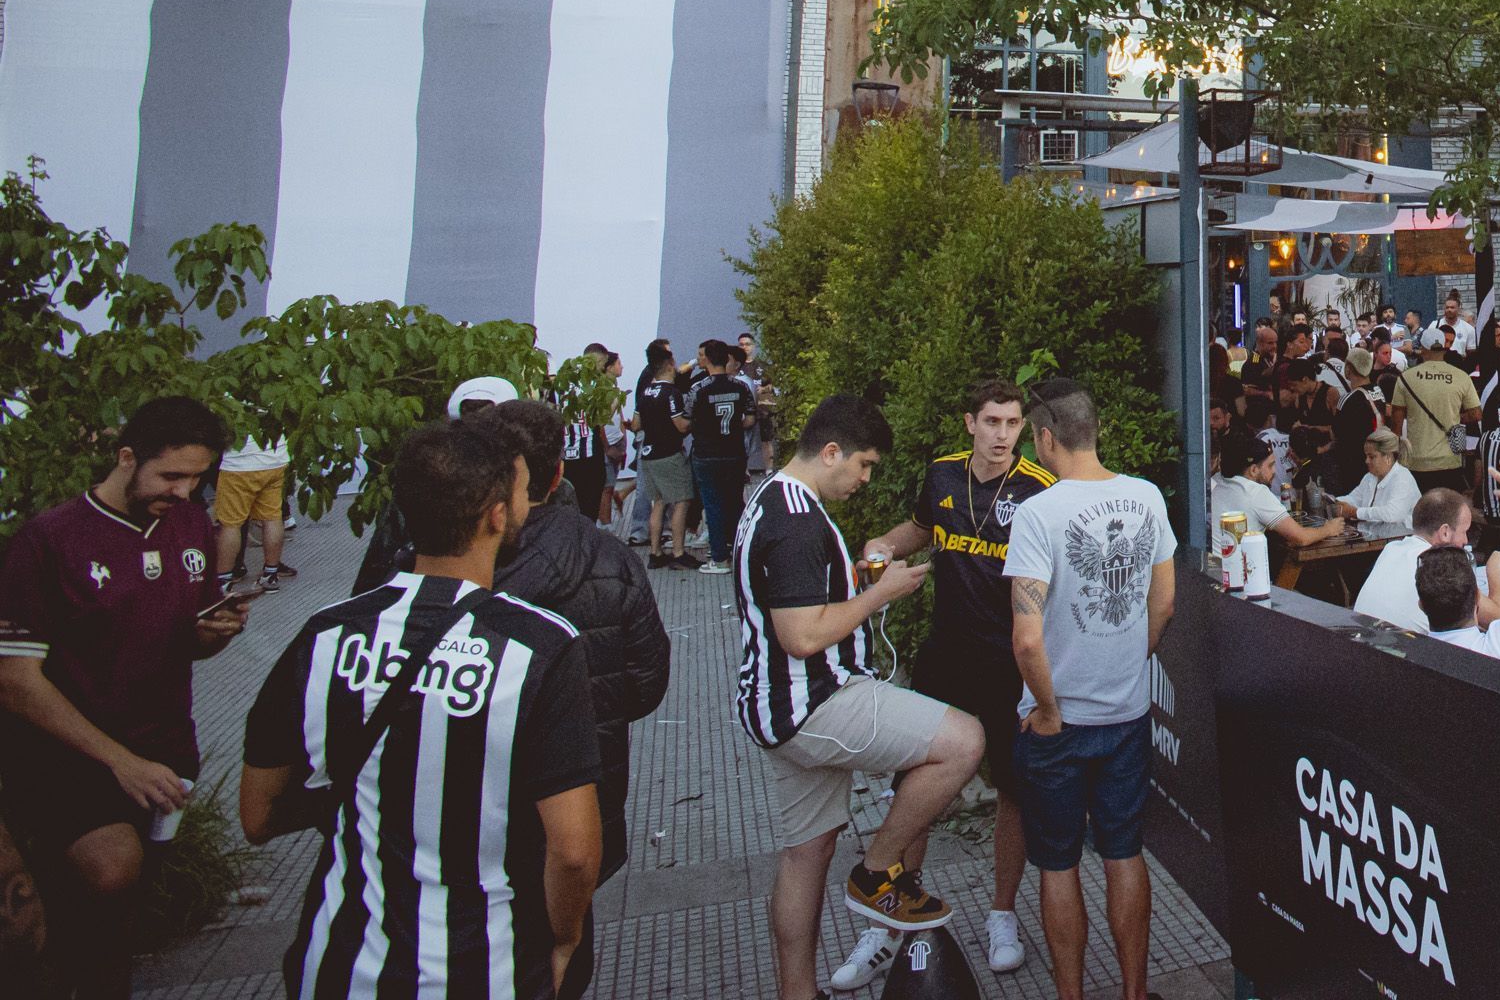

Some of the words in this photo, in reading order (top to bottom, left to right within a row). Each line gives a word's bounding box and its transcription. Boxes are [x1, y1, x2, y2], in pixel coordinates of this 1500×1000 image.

[1425, 371, 1453, 384] bmg
[715, 402, 735, 435] 7
[1078, 500, 1144, 527] ALVINEGRO
[1104, 557, 1132, 569] CAM
[437, 639, 483, 656] GALO
[1151, 717, 1181, 766] MRV
[1295, 757, 1385, 855] CASA
[1391, 805, 1449, 894] DA
[1299, 817, 1456, 987] MASSA
[1271, 903, 1283, 917] CASA
[1290, 915, 1305, 933] MASSA
